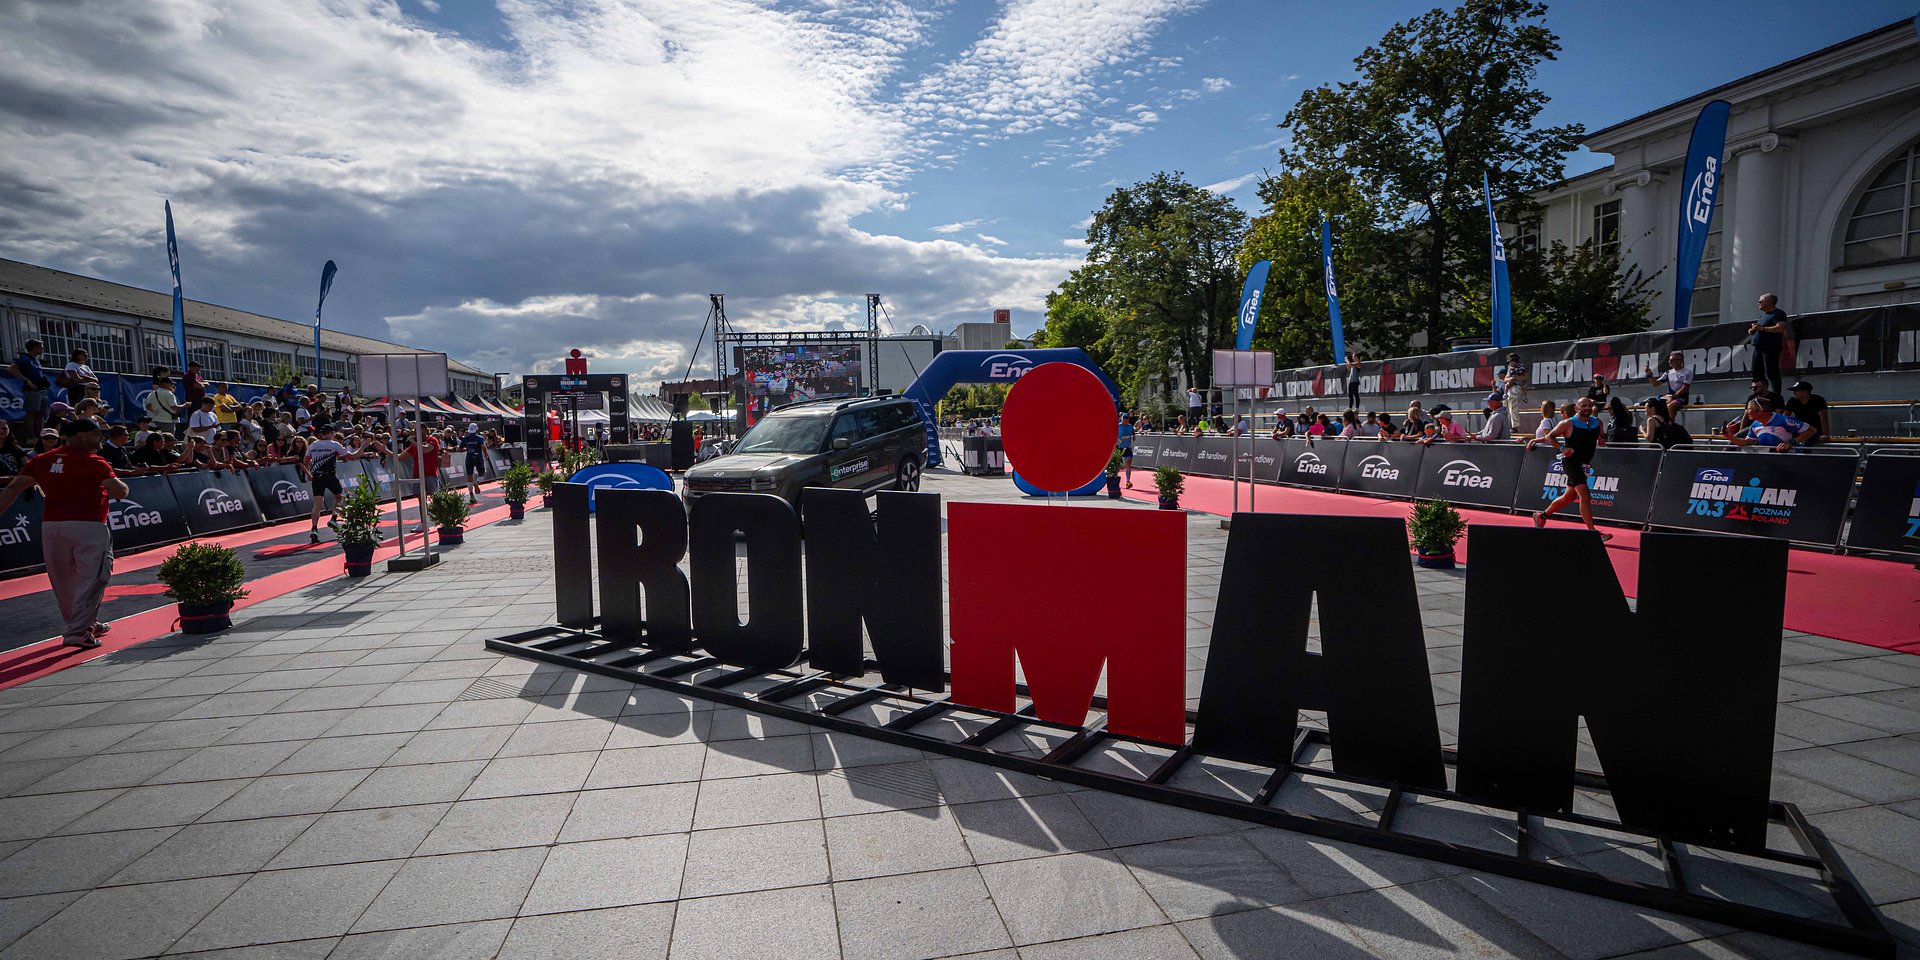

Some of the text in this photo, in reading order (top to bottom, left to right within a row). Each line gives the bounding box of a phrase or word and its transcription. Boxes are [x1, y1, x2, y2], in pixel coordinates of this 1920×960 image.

[1693, 156, 1717, 224] Enea
[1245, 289, 1260, 325] Enea
[1681, 335, 1860, 376] RONAN
[990, 362, 1034, 378] Ene
[1430, 366, 1507, 390] IRONM
[1532, 352, 1659, 385] IRONMAN
[1347, 372, 1418, 394] IONMAN
[832, 460, 869, 477] enterprise
[1297, 460, 1327, 475] Enea
[1361, 464, 1400, 480] Enea
[1443, 470, 1493, 489] Enea
[1544, 472, 1619, 492] IROAN
[1702, 473, 1729, 482] Enea
[278, 488, 310, 504] Enea
[1541, 486, 1567, 501] 70.
[1690, 482, 1797, 507] IRONMAN
[205, 499, 243, 515] Enea
[1686, 499, 1791, 518] 70.3 POZNAŃ
[108, 510, 162, 531] Enea
[1751, 515, 1790, 525] POLAND
[553, 482, 1789, 853] IRONMAN
